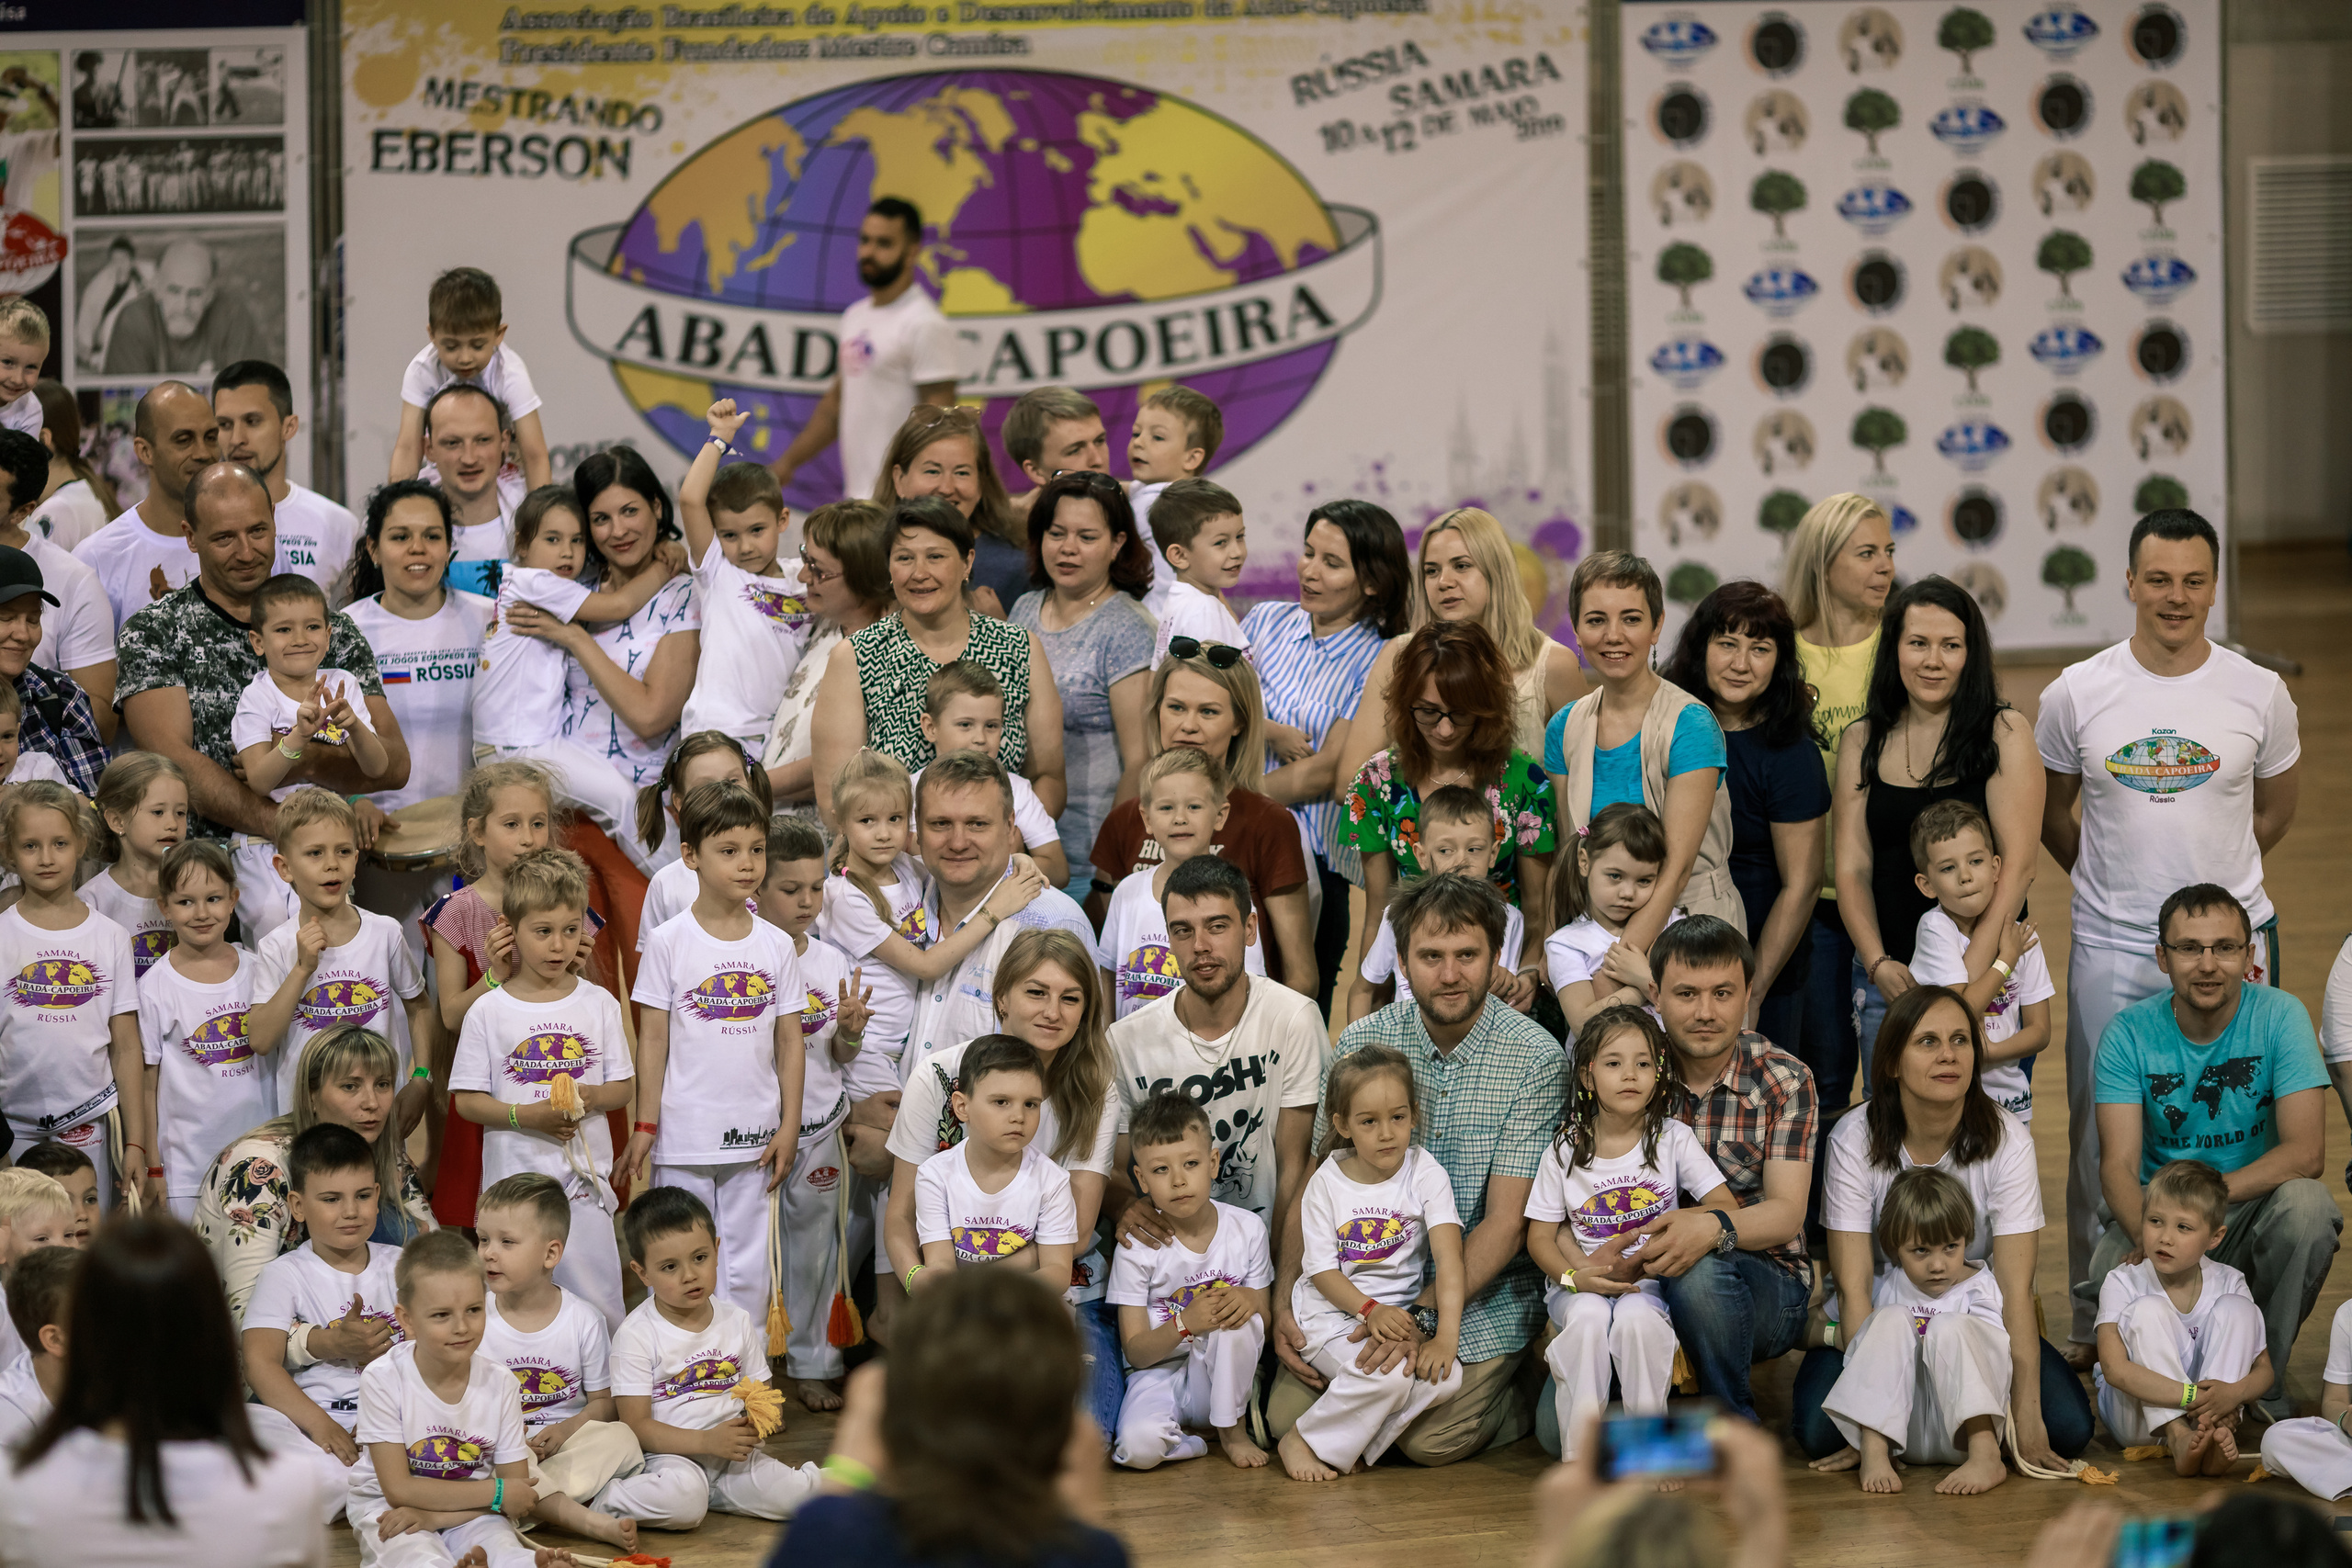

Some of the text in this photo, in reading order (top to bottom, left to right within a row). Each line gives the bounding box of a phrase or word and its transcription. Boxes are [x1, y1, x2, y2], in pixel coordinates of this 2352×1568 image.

[1387, 51, 1561, 118] SAMARA
[423, 75, 664, 136] MESTRANDO
[369, 127, 632, 183] EBERSON
[468, 650, 479, 660] 201
[2149, 795, 2176, 804] Rússia
[1140, 932, 1170, 943] SAMA
[36, 949, 81, 960] SAMARA
[714, 961, 755, 972] SAMARA
[317, 970, 362, 982] SAMARA
[696, 995, 769, 1007] ABADÁ-CAPOEIRA
[205, 1001, 247, 1018] SAMARA
[302, 1001, 379, 1016] ABADÁ-CAPOEIRA
[37, 1013, 78, 1023] RÚSSIA
[529, 1022, 573, 1033] SAMARA
[720, 1025, 758, 1035] RÚSSIA
[194, 1037, 250, 1050] ABADÁ-CAPO
[221, 1064, 255, 1077] RÚSSIA
[2158, 1119, 2267, 1149] THE WORLD OF
[1593, 1176, 1638, 1191] SAMARA
[1351, 1206, 1395, 1216] SAMARA
[1581, 1203, 1661, 1224] ABADÁ-CAPOEIRA
[964, 1216, 1010, 1226] SAMARA
[1183, 1269, 1224, 1284] SAMARA
[1910, 1305, 1938, 1316] AMAR
[505, 1356, 551, 1368] SAMARA
[684, 1348, 723, 1365] SAMARA
[425, 1425, 468, 1438] SAMARA
